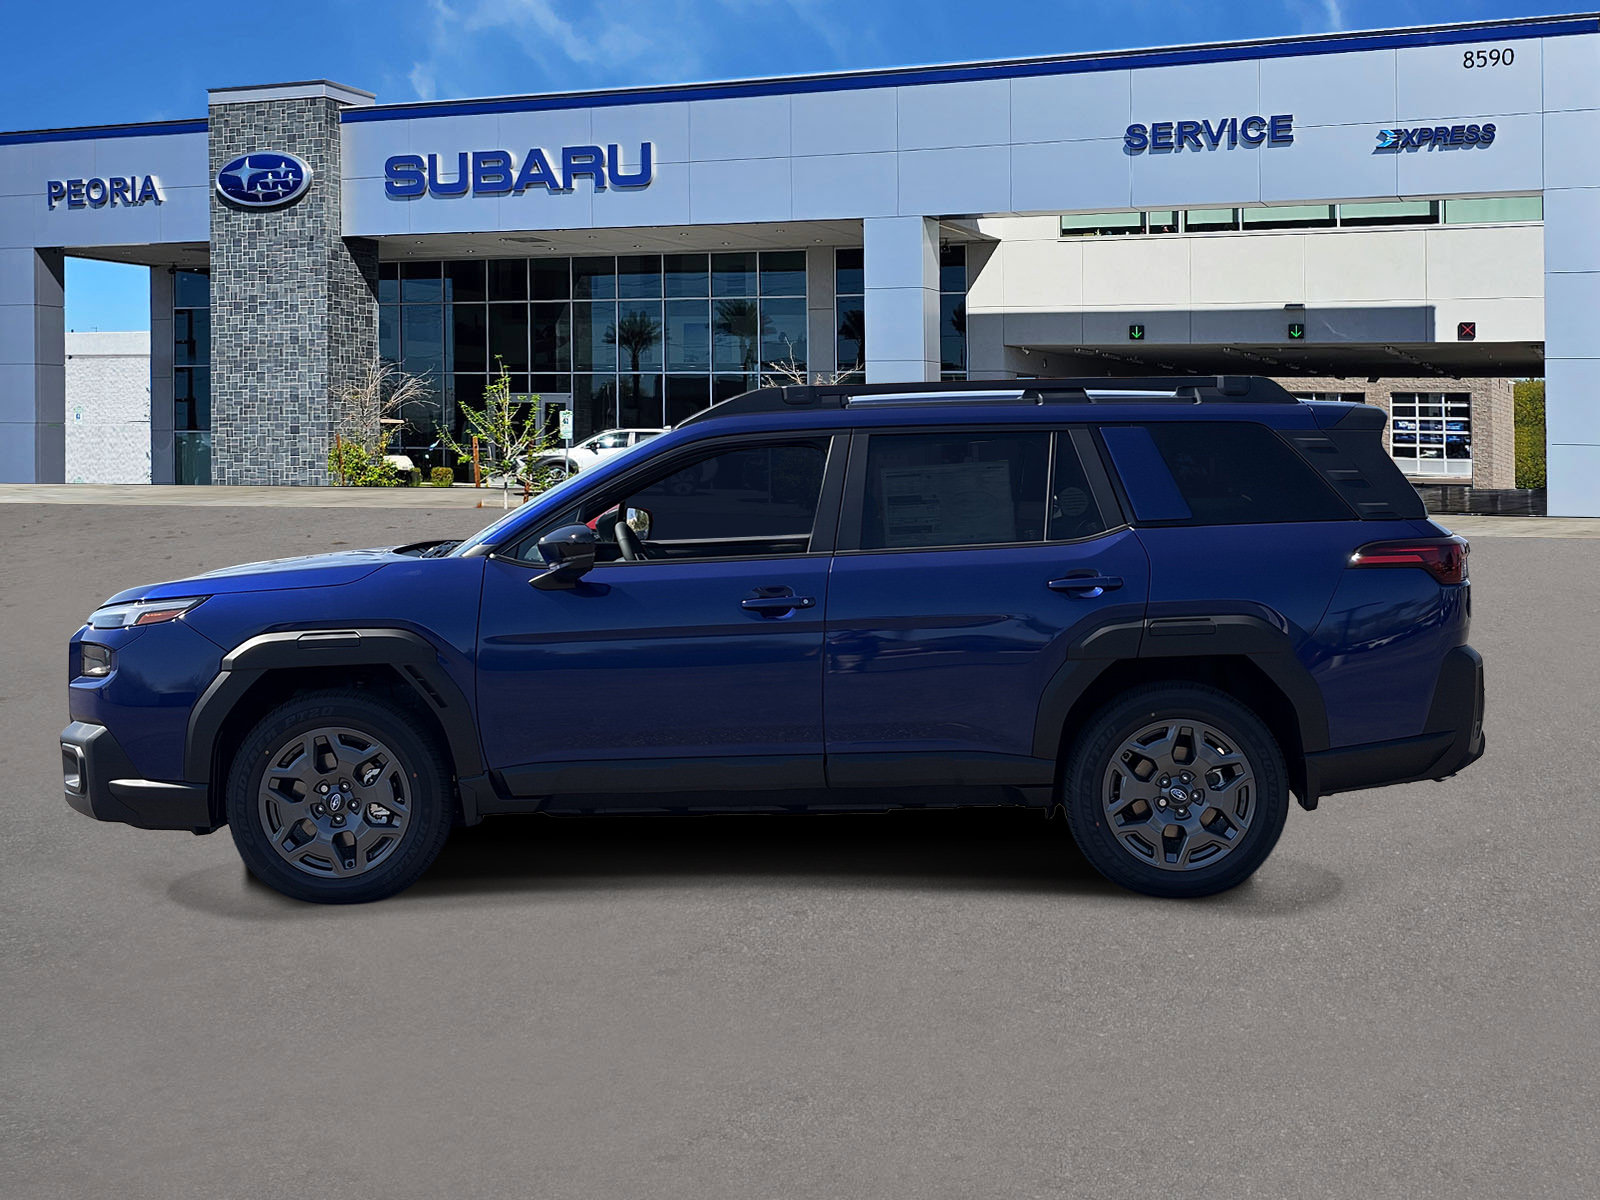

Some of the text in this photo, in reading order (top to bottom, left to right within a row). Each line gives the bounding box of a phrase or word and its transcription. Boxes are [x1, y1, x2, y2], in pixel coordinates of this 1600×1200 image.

[1462, 48, 1515, 69] 8590
[1125, 114, 1294, 150] SERVICE
[1375, 123, 1497, 149] EXPRESS
[384, 142, 652, 197] SUBARU
[47, 175, 162, 206] PEORIA
